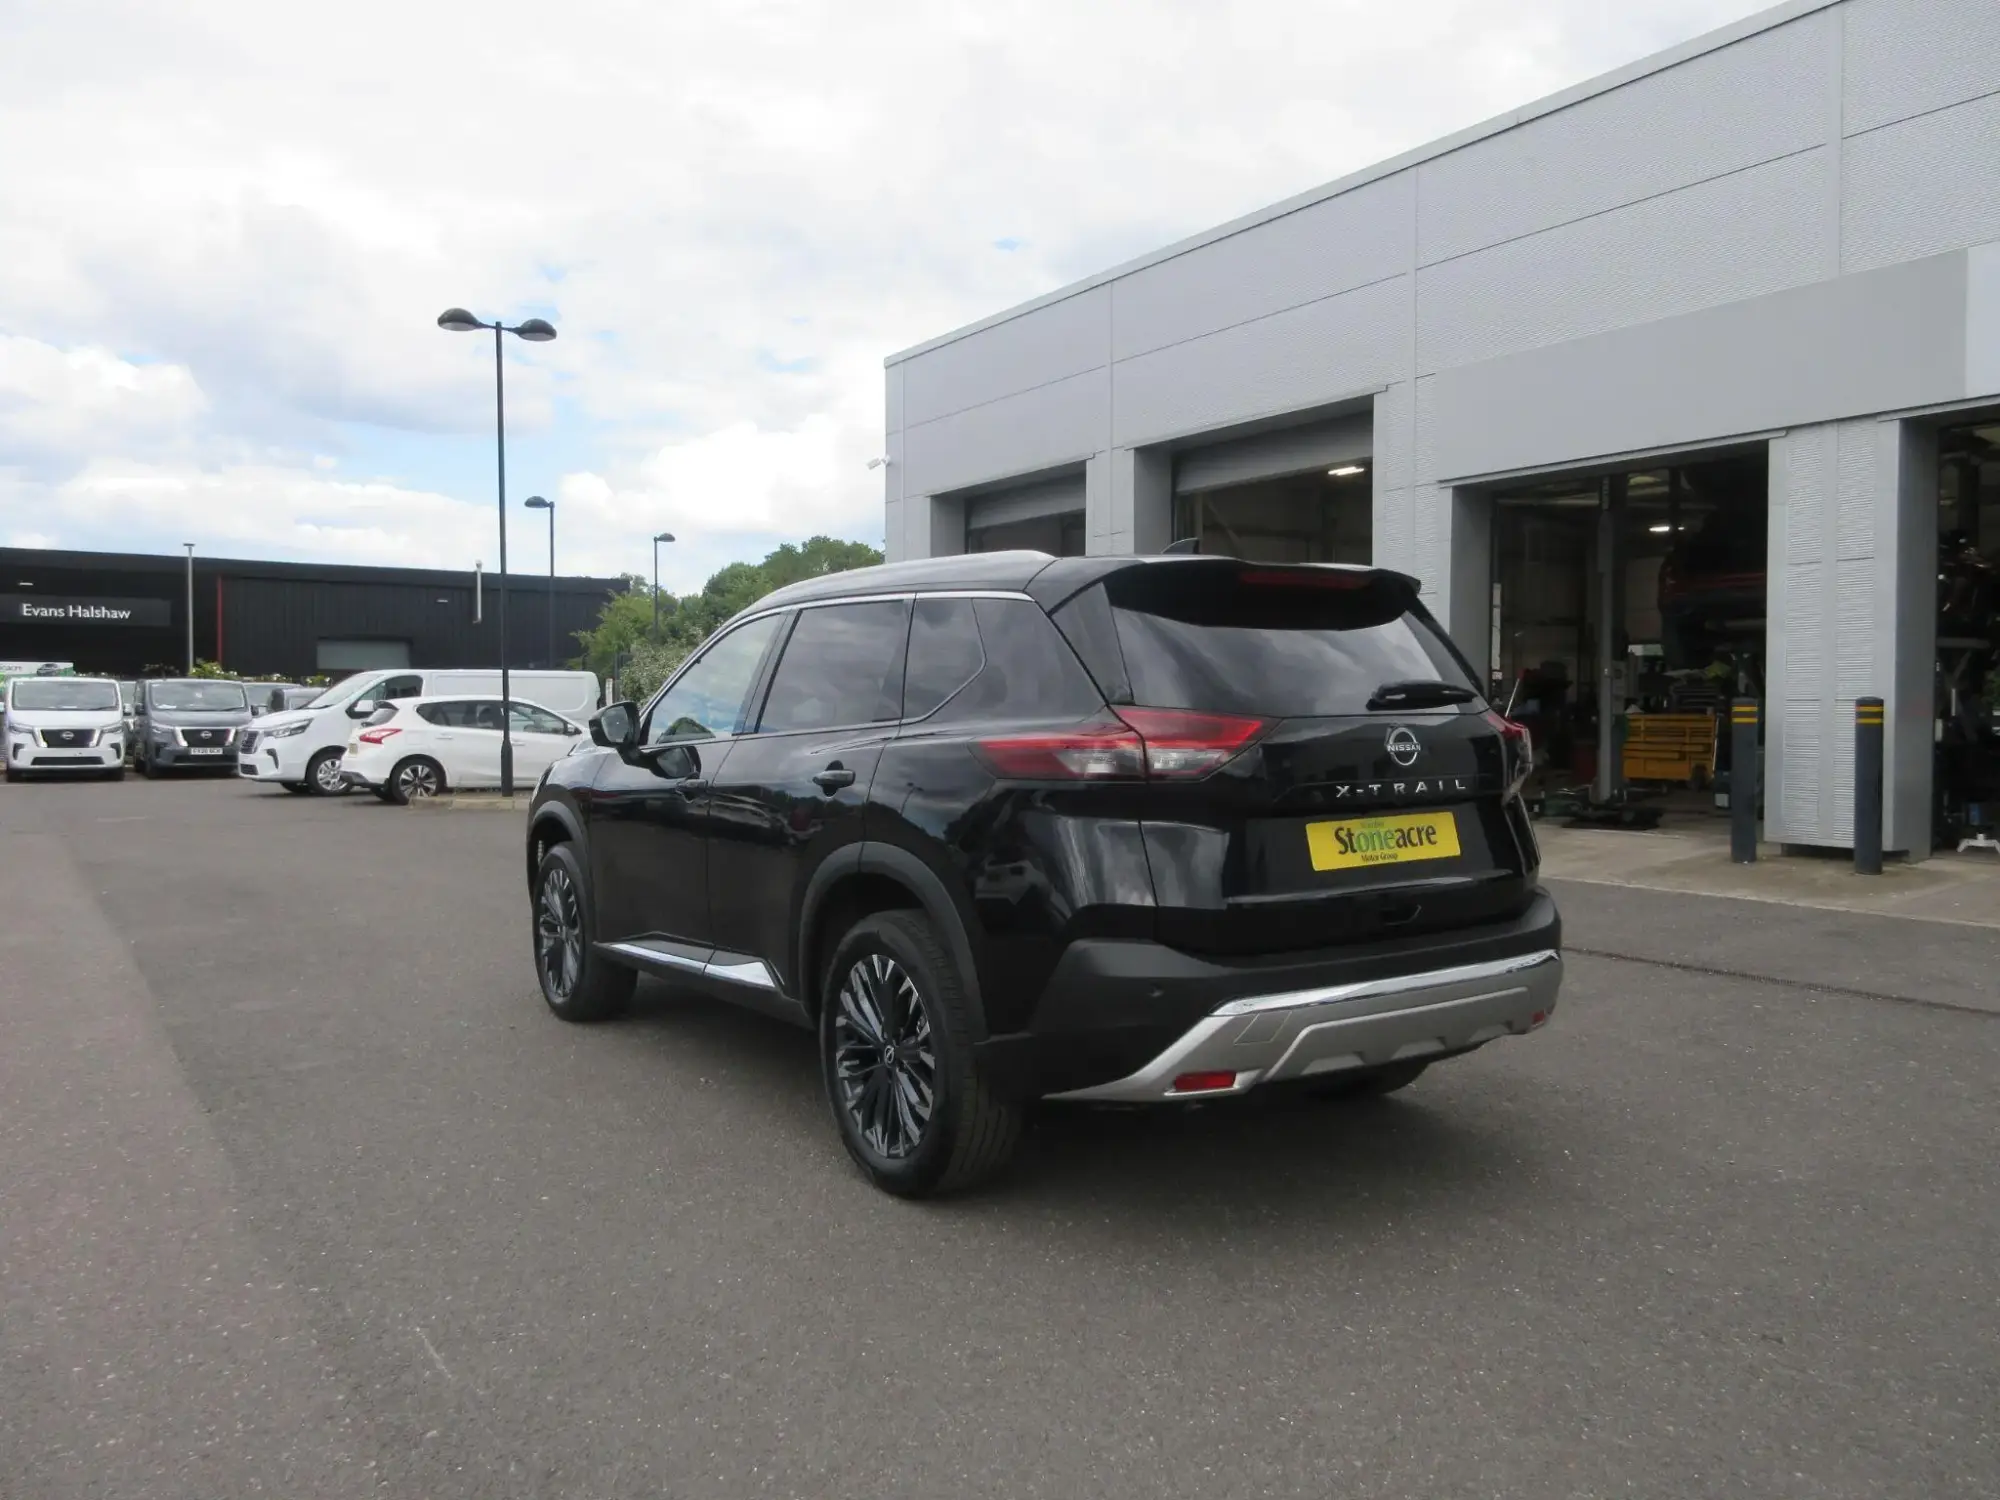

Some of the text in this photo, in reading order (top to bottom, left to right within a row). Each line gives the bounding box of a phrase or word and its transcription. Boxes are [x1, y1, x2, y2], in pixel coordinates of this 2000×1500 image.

[21, 603, 132, 620] Evans Halshaw
[1387, 743, 1421, 752] NISSAN
[1335, 779, 1467, 798] X-TRAIL
[1334, 824, 1437, 855] Stoneacre
[1361, 851, 1399, 862] Motor Group
